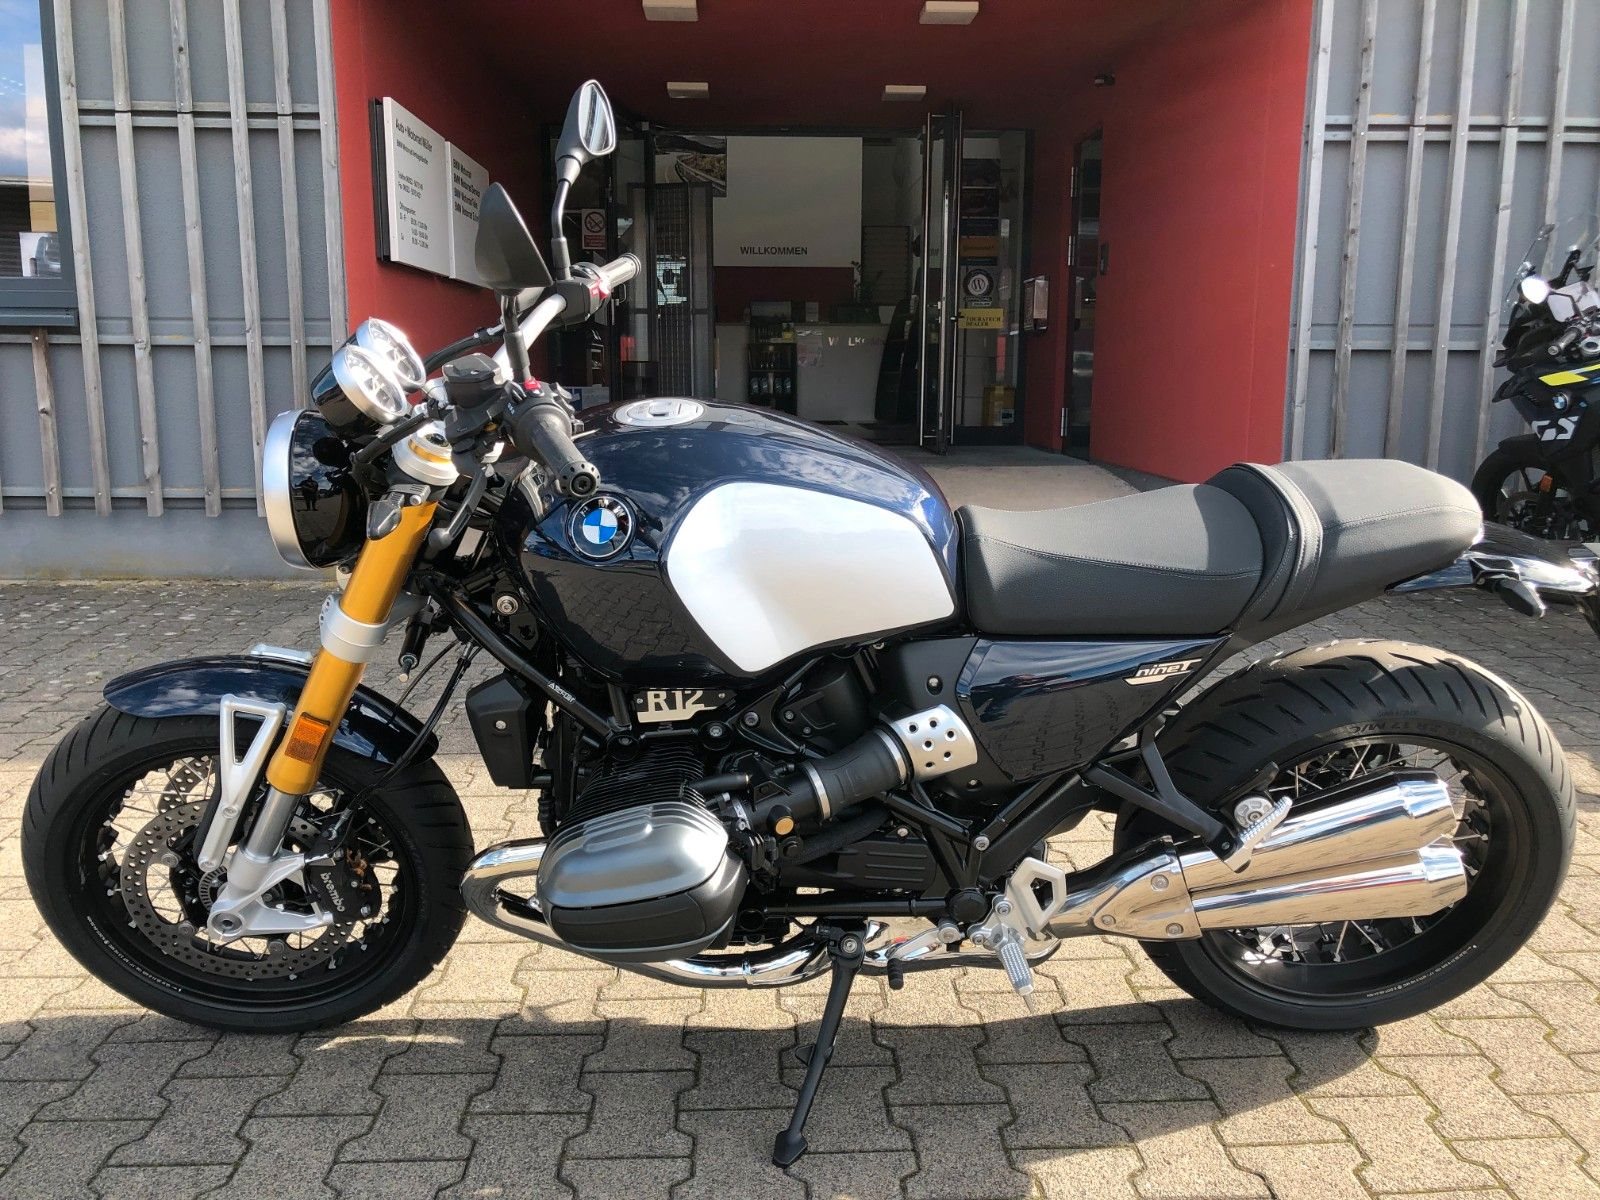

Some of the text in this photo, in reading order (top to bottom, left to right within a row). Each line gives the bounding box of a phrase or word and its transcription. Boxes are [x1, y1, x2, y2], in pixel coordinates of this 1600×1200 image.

[740, 246, 808, 256] WILLKOMMEN
[1531, 416, 1580, 441] GS
[646, 690, 706, 713] R12
[320, 872, 345, 912] brembo
